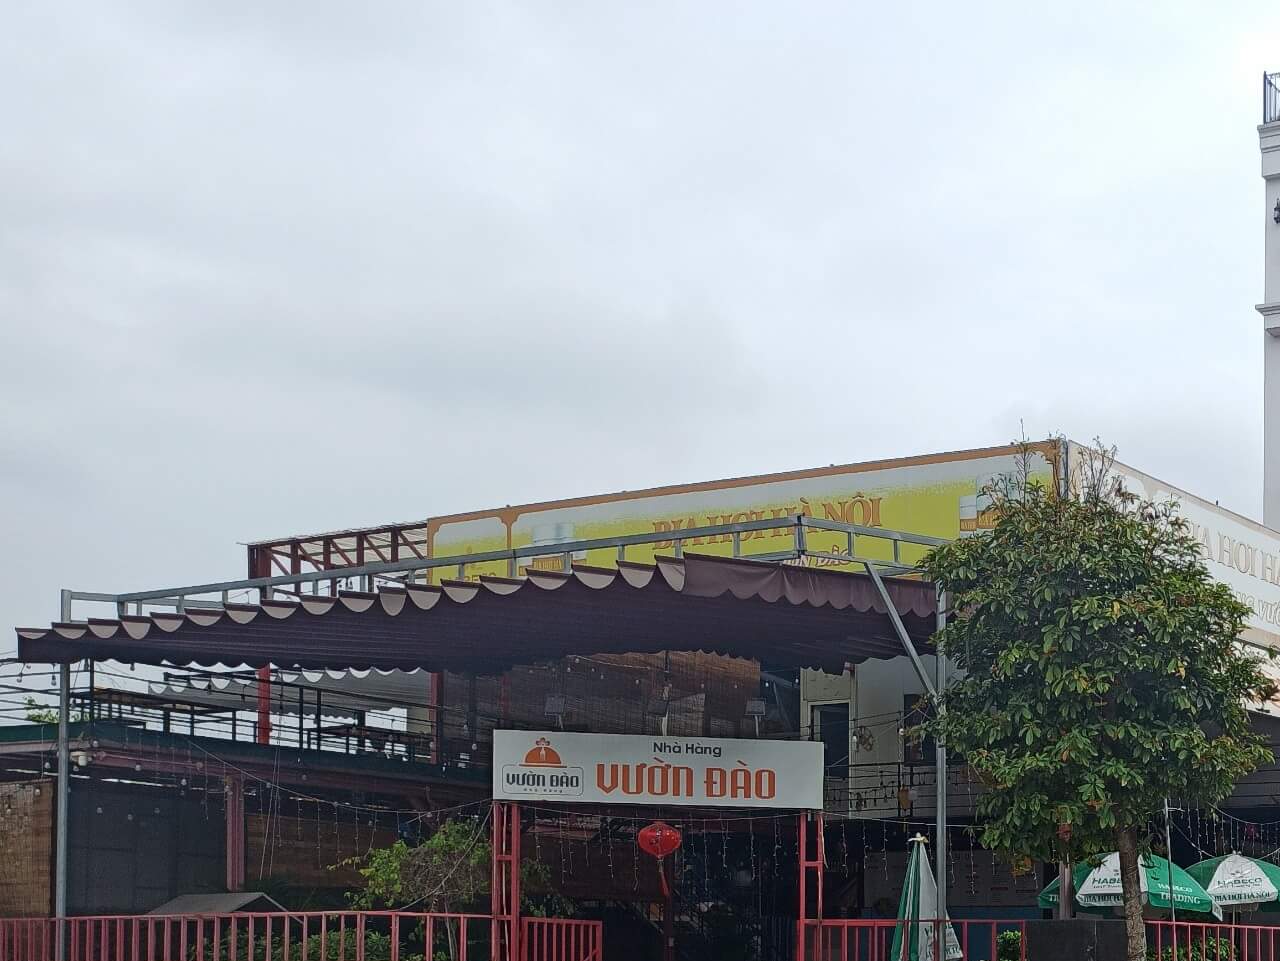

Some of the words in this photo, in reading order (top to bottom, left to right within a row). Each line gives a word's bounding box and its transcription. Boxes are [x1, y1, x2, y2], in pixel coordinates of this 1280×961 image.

[653, 741, 681, 753] Nhà
[685, 743, 722, 758] Hàng
[596, 757, 693, 797] VƯỜN
[704, 760, 776, 800] ĐÀO
[1160, 892, 1201, 904] TRADING
